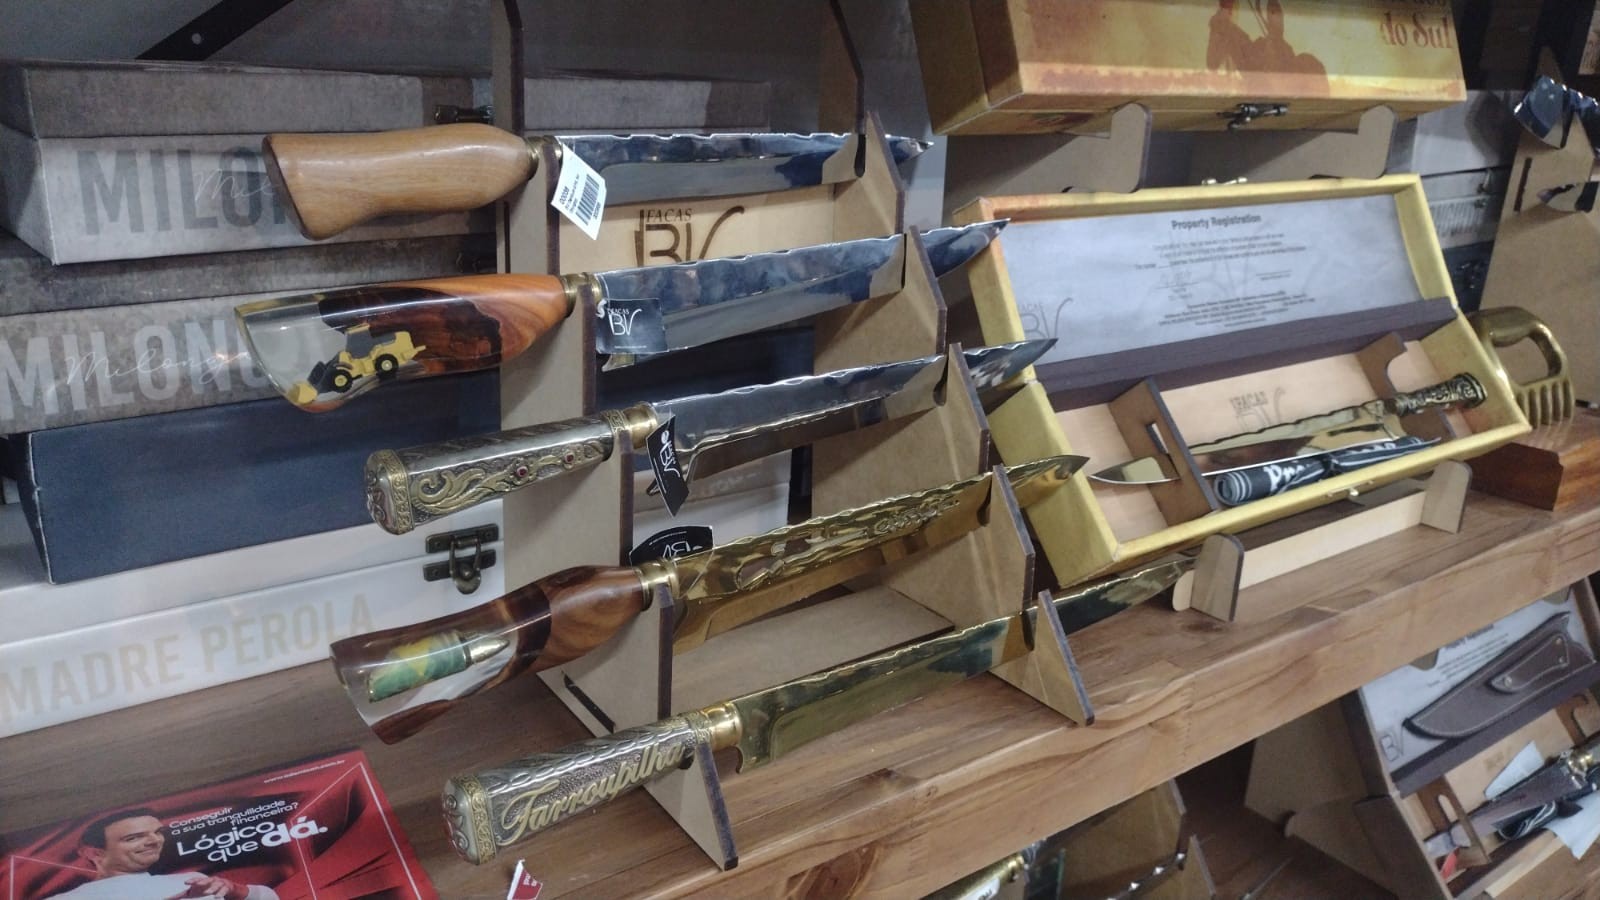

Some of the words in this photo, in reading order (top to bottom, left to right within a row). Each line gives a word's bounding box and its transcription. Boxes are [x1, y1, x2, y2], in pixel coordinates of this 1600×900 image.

[76, 146, 292, 236] MILO
[645, 207, 693, 223] FACAS
[1171, 217, 1210, 231] Property
[1210, 213, 1262, 228] Registration
[0, 634, 186, 721] MADRE
[496, 742, 686, 846] Farroupilha
[168, 806, 234, 830] Conseguir
[171, 827, 181, 836] a
[182, 821, 207, 834] sua
[207, 799, 287, 827] tranquilidade
[229, 801, 299, 827] financeira?
[176, 820, 276, 857] Lógico
[207, 839, 259, 863] que
[260, 815, 329, 848] dá.
